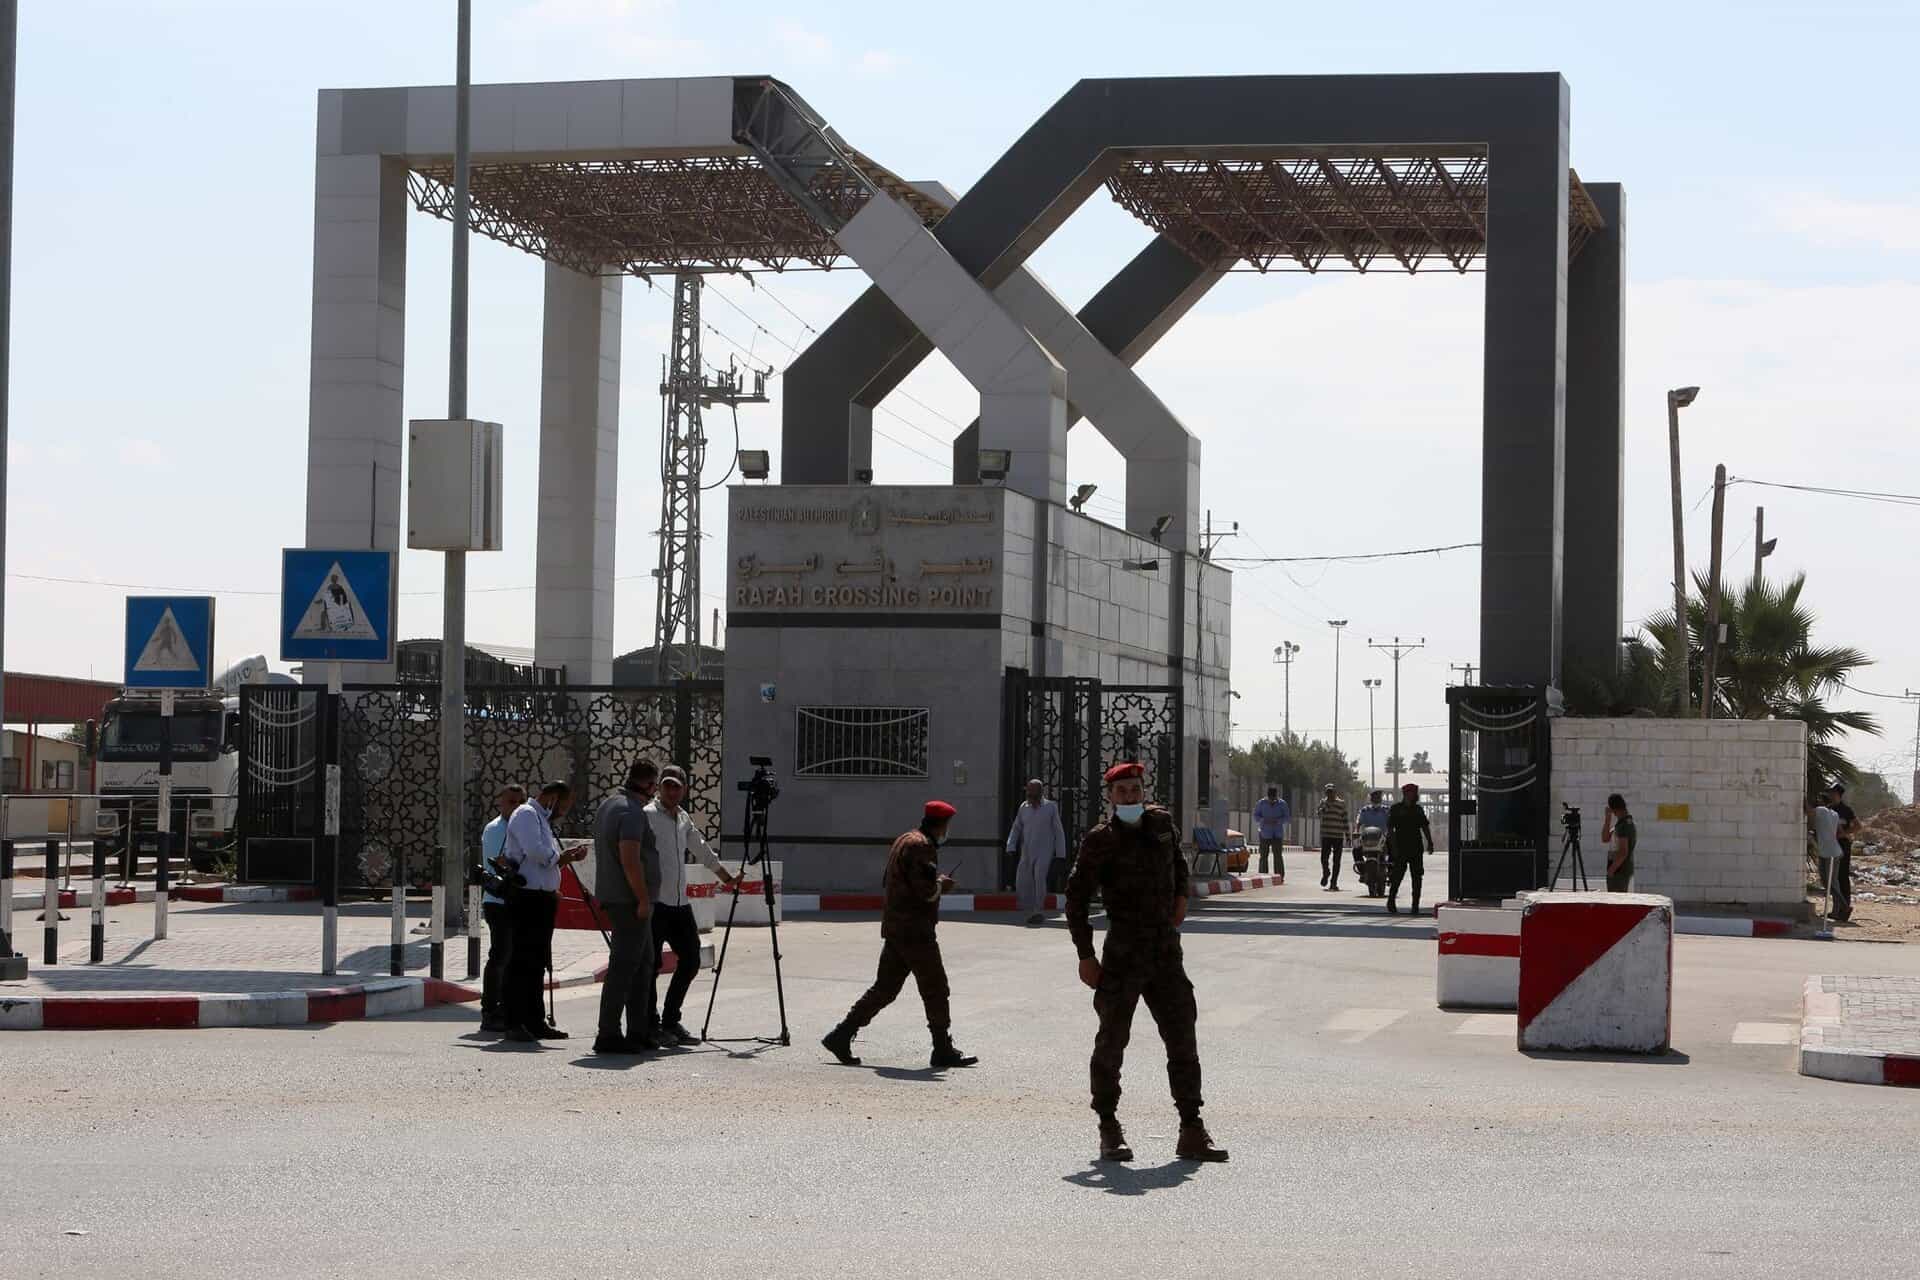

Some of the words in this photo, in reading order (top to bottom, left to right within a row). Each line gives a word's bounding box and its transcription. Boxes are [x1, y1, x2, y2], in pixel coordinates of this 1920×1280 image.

[736, 586, 804, 607] RAFAH
[810, 586, 920, 607] CROSSING
[928, 586, 993, 607] POINT
